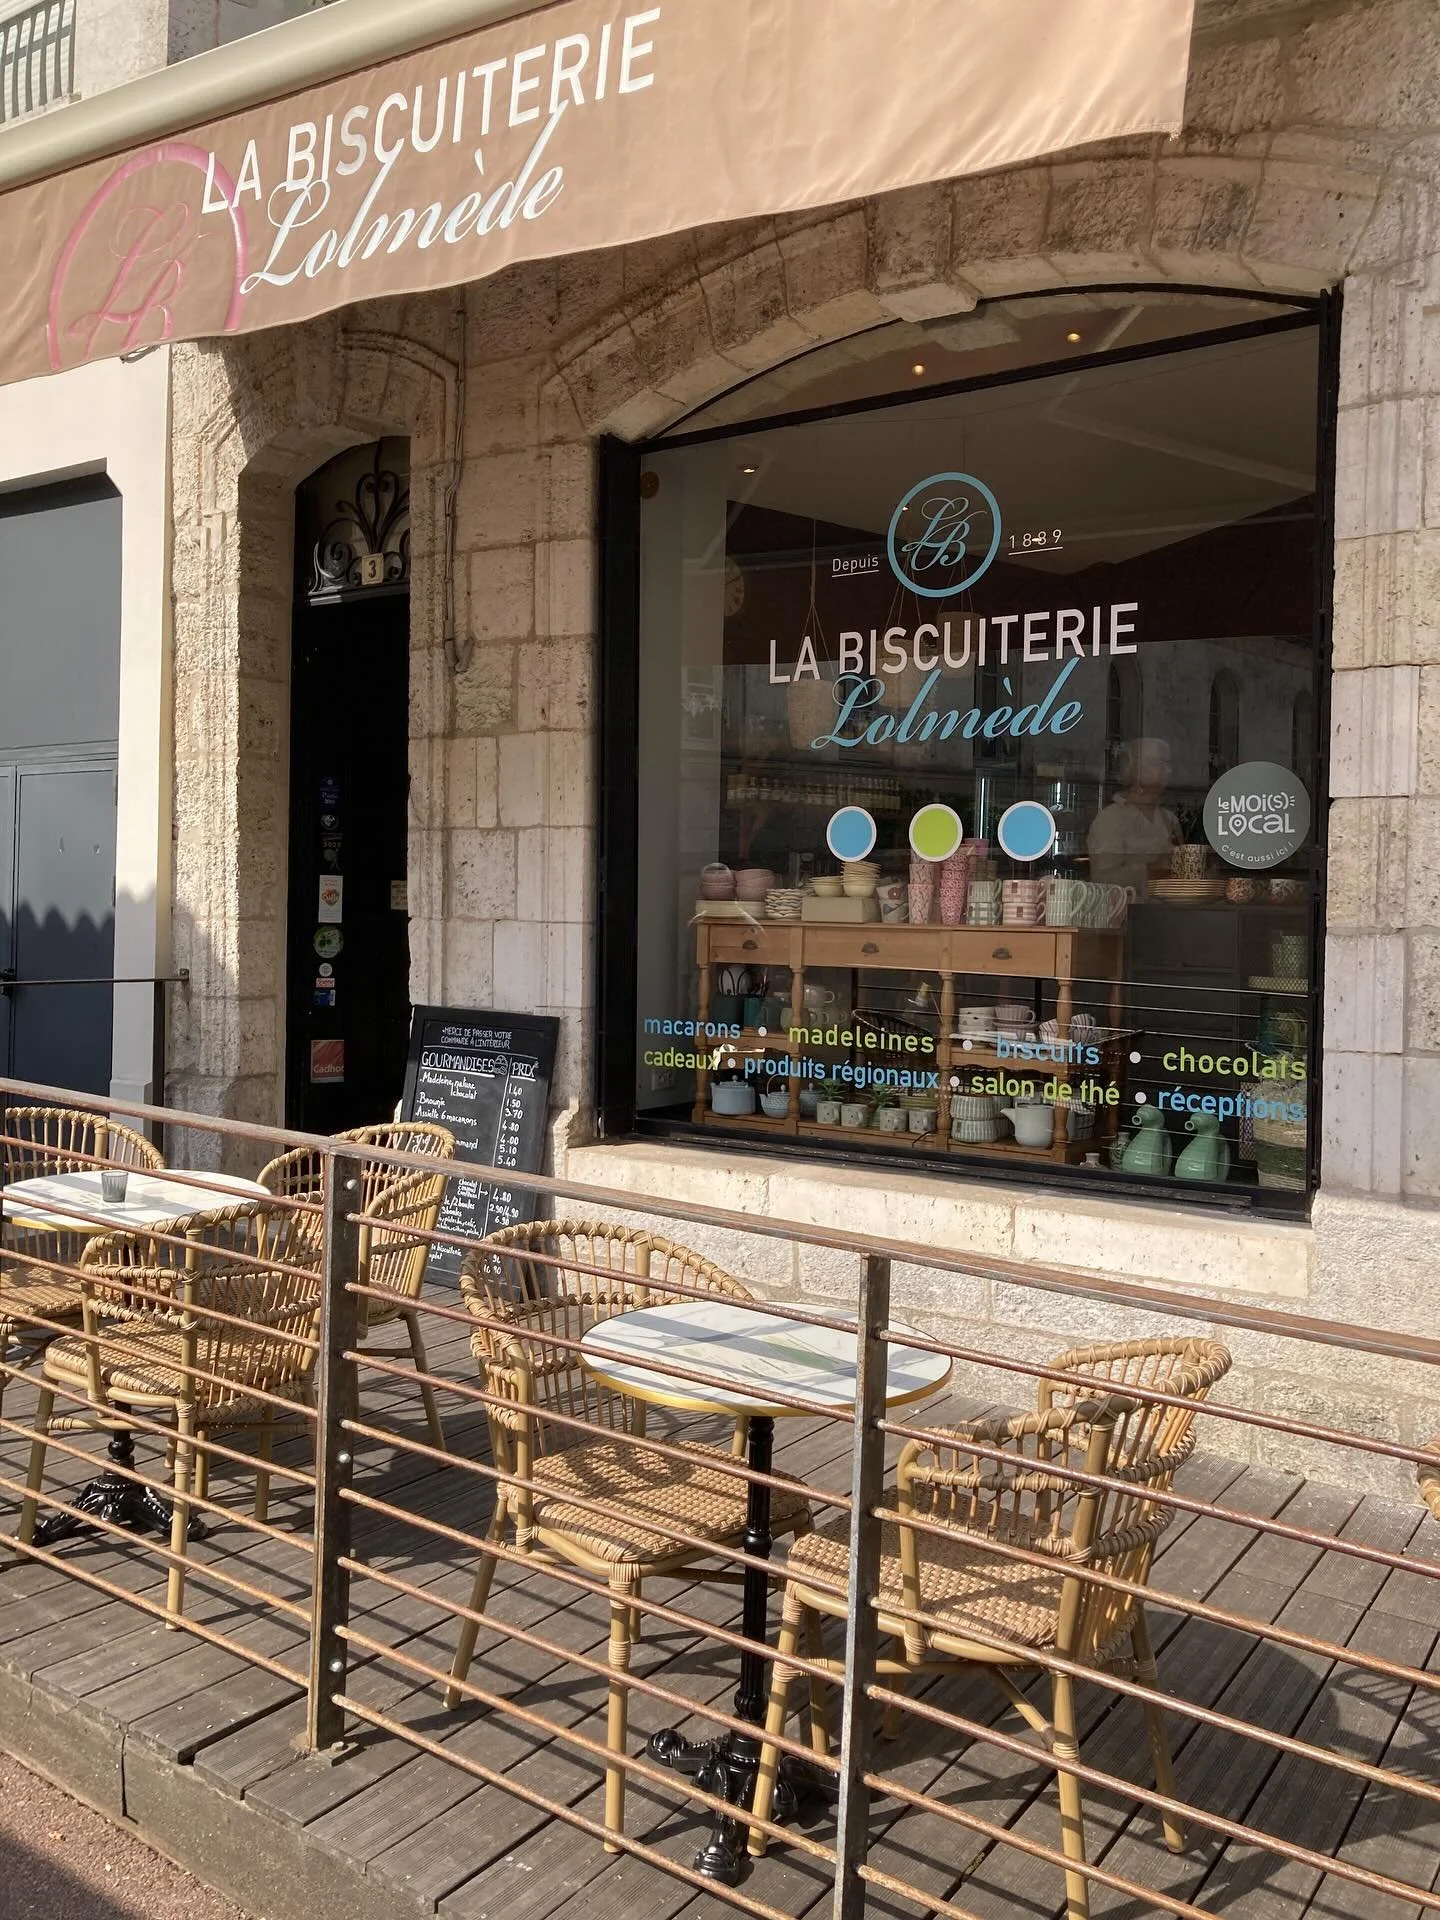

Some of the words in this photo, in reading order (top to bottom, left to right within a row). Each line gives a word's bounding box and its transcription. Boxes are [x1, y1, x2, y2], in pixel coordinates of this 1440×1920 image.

[200, 146, 264, 214] LA
[285, 7, 661, 193] BISCUITERIE
[239, 101, 565, 295] Lolmède
[368, 559, 377, 579] 3
[832, 554, 879, 573] Depuis
[769, 636, 821, 684] LA
[838, 602, 1139, 677] BISCUITERIE
[810, 656, 1084, 750] Lolmède
[1247, 852, 1274, 862] aussi
[440, 1035, 469, 1045] COMMANDE
[464, 1028, 471, 1037] DE
[472, 1028, 493, 1038] PASSER
[494, 1031, 512, 1040] VOTRE
[643, 1017, 741, 1040] macarons
[789, 1025, 935, 1053] madeleines
[996, 1036, 1100, 1065] biscuits
[1163, 1047, 1307, 1081] chocolats
[421, 1051, 495, 1074] GOURMANDISES
[511, 1061, 535, 1078] PRIX
[508, 1083, 523, 1097] 1.40
[643, 1048, 719, 1070] cadeaux
[744, 1056, 826, 1079] produits
[832, 1058, 939, 1089] régionaux
[970, 1072, 1035, 1097] salon
[1043, 1077, 1073, 1102] de
[1080, 1080, 1120, 1106] thé
[1158, 1086, 1306, 1122] réceptions
[506, 1098, 521, 1108] 1.50
[441, 1110, 447, 1120] 6
[505, 1108, 523, 1119] 3.70
[500, 1133, 519, 1145] 4.00
[500, 1144, 517, 1155] 5.10
[497, 1155, 516, 1167] 5.40
[493, 1188, 512, 1203] 4.80
